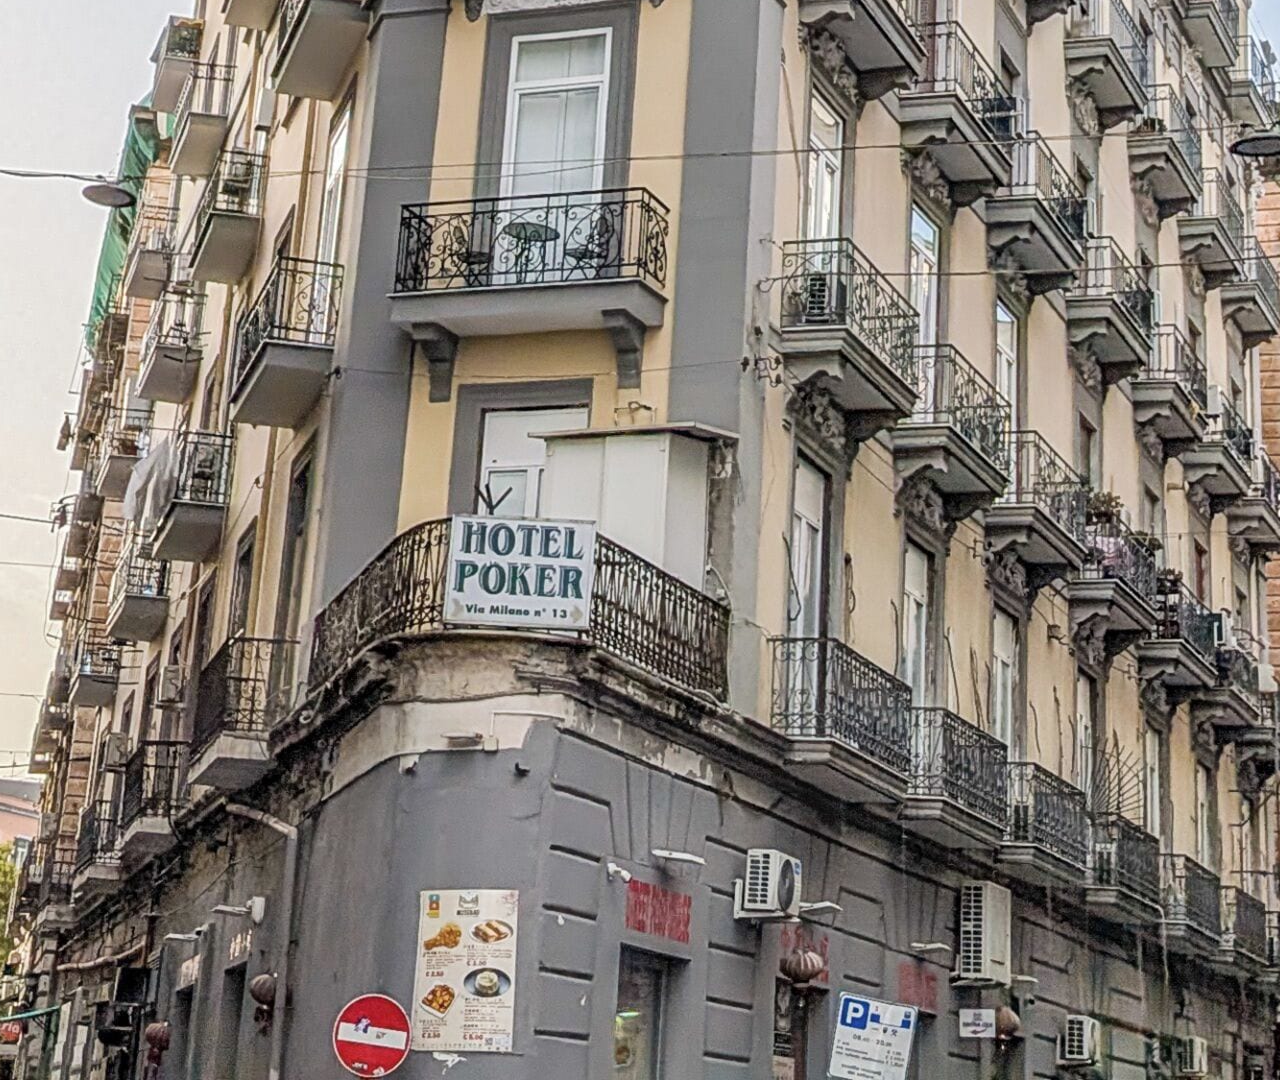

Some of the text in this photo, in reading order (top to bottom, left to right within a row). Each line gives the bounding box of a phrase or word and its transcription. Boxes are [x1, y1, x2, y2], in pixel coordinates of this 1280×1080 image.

[459, 520, 584, 560] HOTEL
[452, 559, 584, 599] POKER
[465, 604, 485, 614] Via
[489, 605, 530, 617] Milano
[552, 609, 568, 619] 13
[845, 1001, 865, 1025] P
